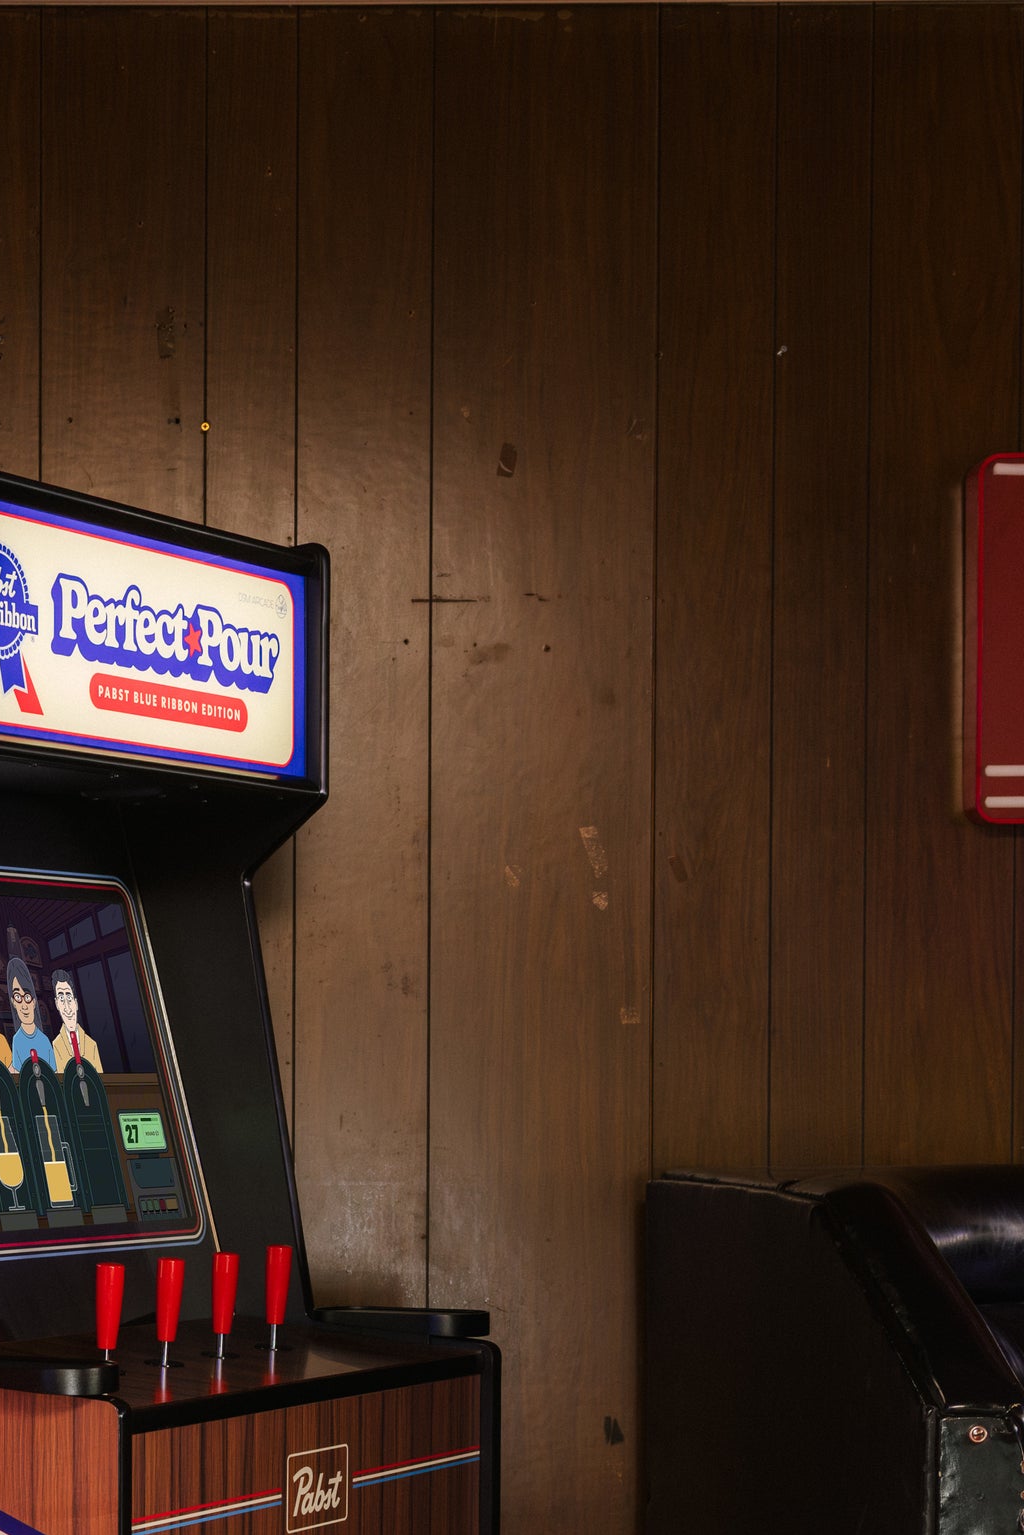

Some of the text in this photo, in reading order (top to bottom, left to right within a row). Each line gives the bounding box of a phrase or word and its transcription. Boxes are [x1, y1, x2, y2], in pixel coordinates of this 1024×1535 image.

[57, 576, 279, 680] Perfect Pour
[97, 685, 241, 721] PABST BLUE RIBBON EDITION
[125, 1124, 139, 1144] 27
[292, 1466, 343, 1517] Pabst
